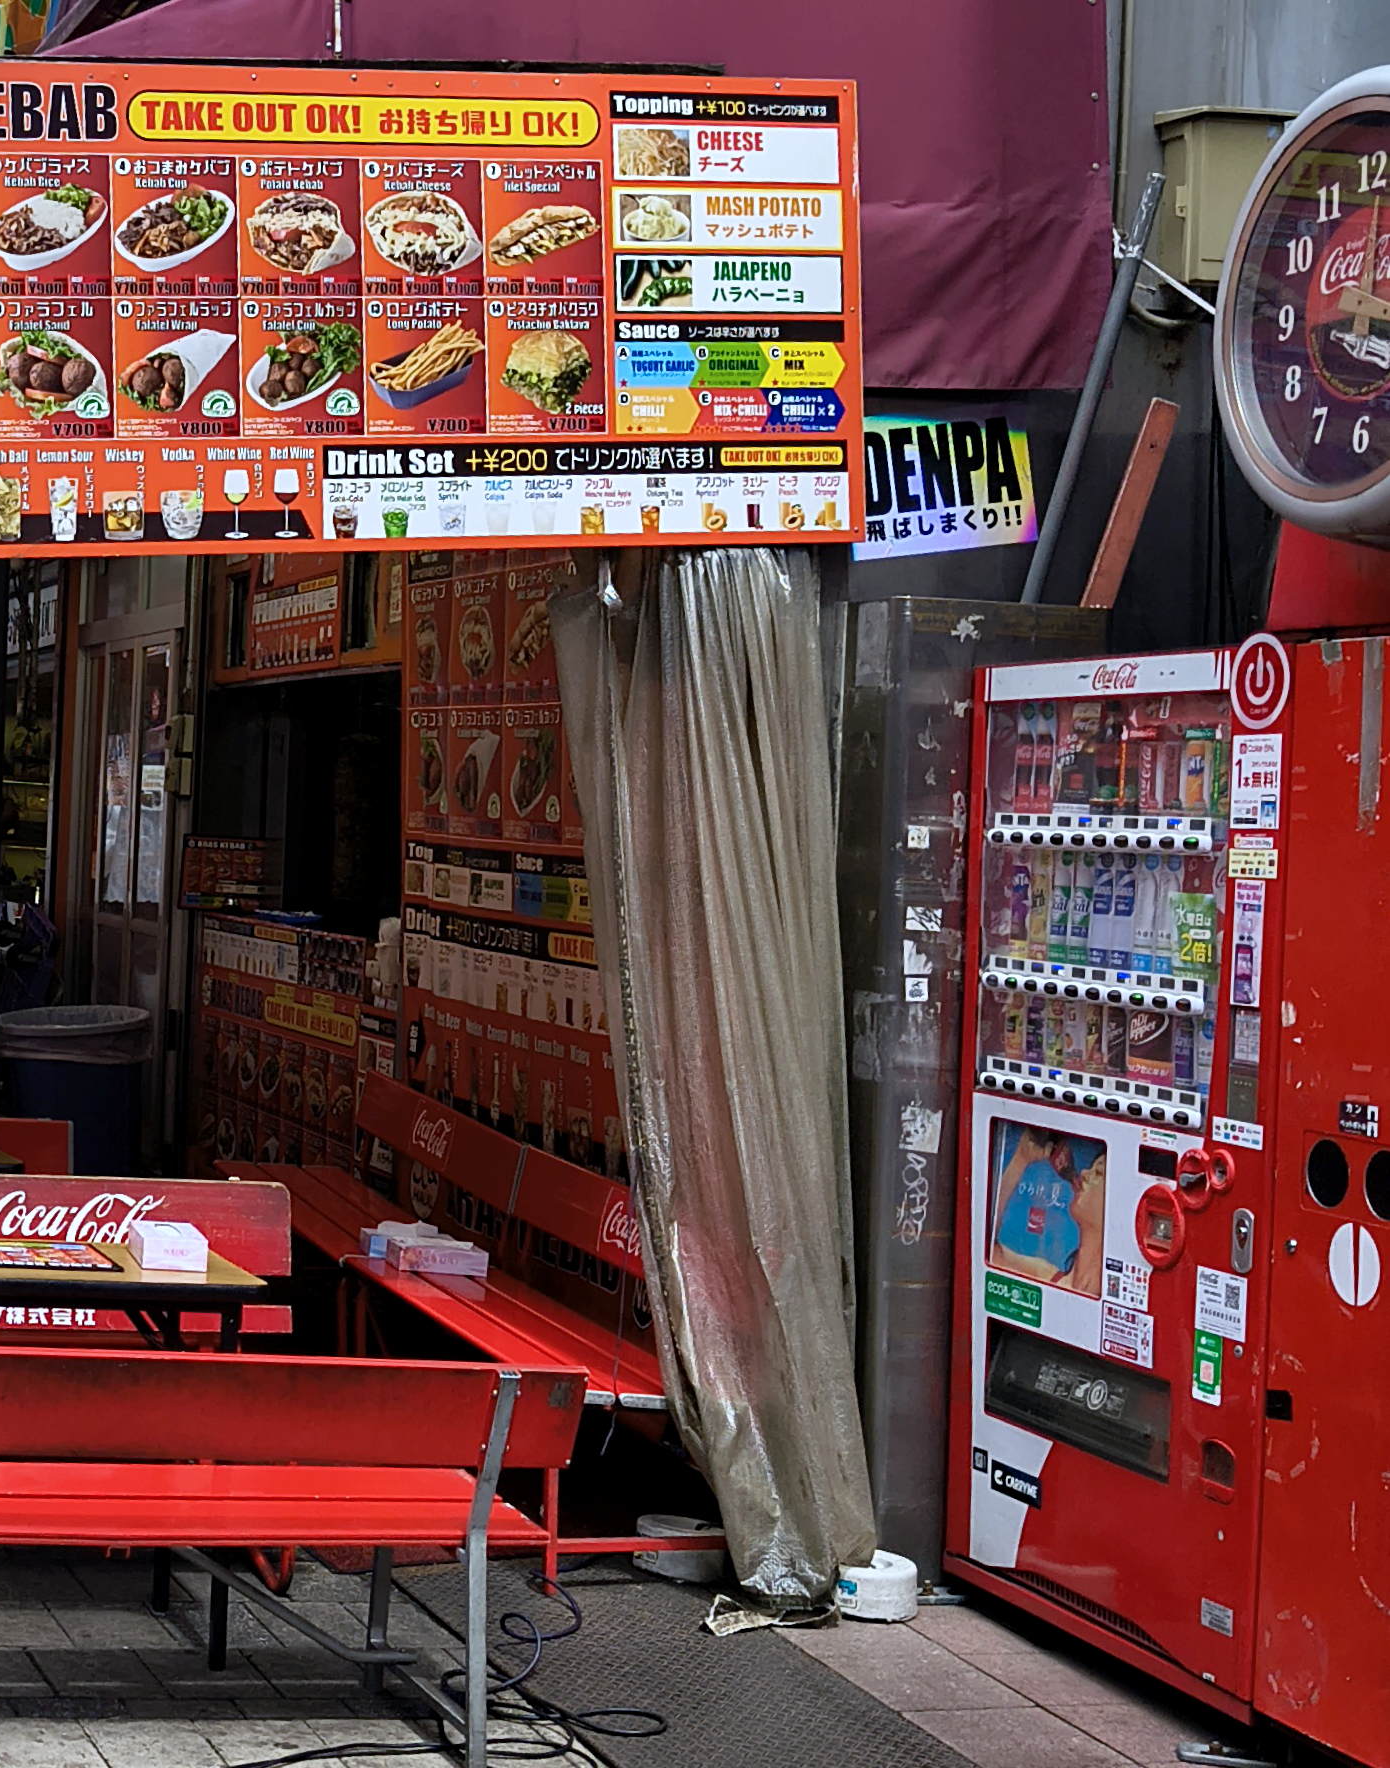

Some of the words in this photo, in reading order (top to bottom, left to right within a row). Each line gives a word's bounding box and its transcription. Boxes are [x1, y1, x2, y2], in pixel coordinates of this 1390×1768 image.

[613, 95, 694, 115] Topping
[696, 100, 746, 117] +¥100
[141, 100, 224, 132] TAKE
[232, 101, 298, 133] OUT
[305, 103, 362, 135] OK!
[378, 109, 511, 137] お持ち帰り
[522, 111, 580, 137] OK!
[697, 130, 764, 152] CHEESE
[698, 156, 746, 174] チーズ
[1357, 150, 1389, 193] 12
[706, 195, 755, 217] MASH
[758, 196, 822, 218] POTATO
[1316, 181, 1341, 224] 11
[705, 222, 814, 240] マッシュポテト
[1285, 235, 1314, 276] 10
[712, 260, 792, 282] JALAPENO
[712, 286, 805, 305] ハラペーニョ
[618, 321, 680, 340] Sauce
[1278, 304, 1295, 342] 9
[1284, 365, 1302, 402] 8
[1312, 407, 1328, 445] 7
[1352, 415, 1370, 454] 6
[36, 449, 70, 463] Lemon
[71, 449, 94, 463] Sour
[105, 448, 145, 464] Wiskey
[162, 447, 196, 463] Vodka
[207, 446, 236, 461] White
[236, 447, 262, 462] Wine
[270, 446, 289, 460] Red
[290, 446, 315, 461] Wine
[327, 449, 404, 476] Drink
[408, 448, 455, 475] Set
[465, 447, 548, 473] +¥200
[864, 415, 1023, 517] DENPA
[1091, 661, 1141, 692] Coca-Cola
[1175, 904, 1212, 927] 水曜日は
[1179, 932, 1213, 964] 2倍!
[1345, 1102, 1362, 1114] カン
